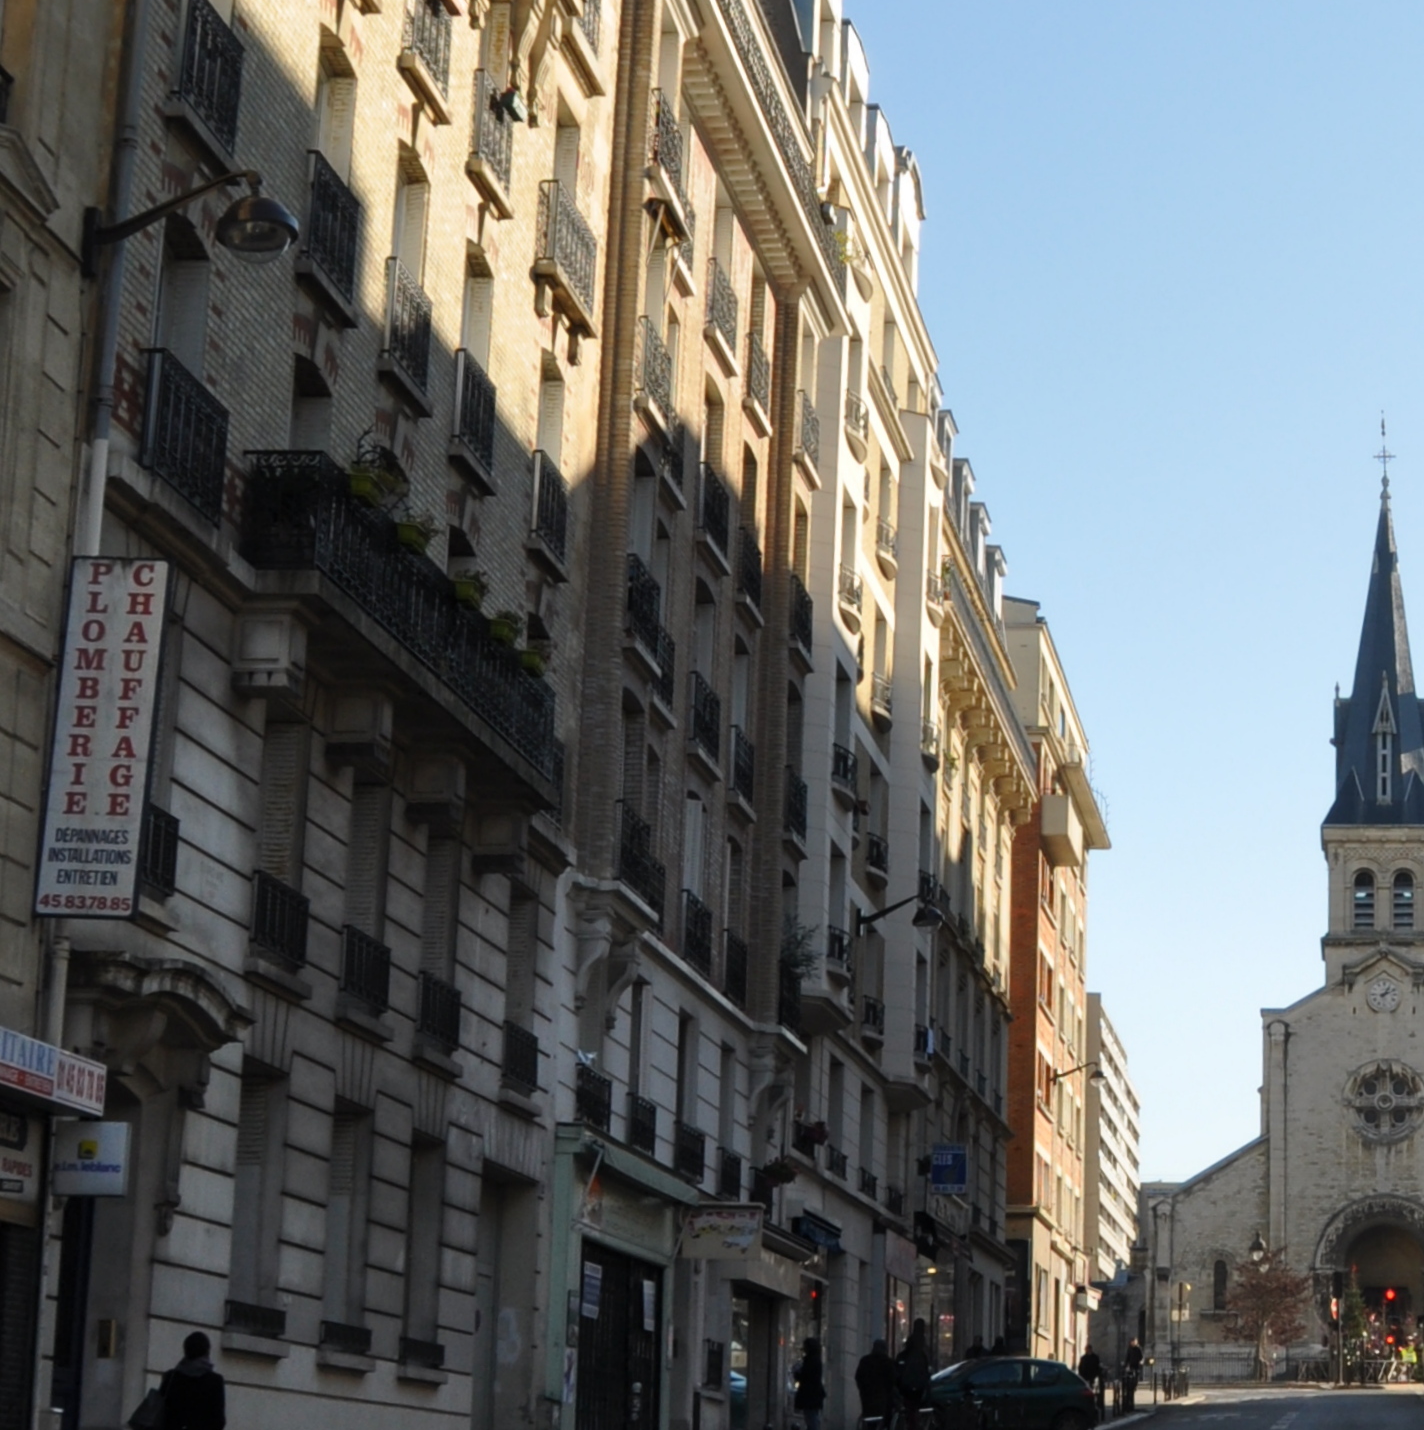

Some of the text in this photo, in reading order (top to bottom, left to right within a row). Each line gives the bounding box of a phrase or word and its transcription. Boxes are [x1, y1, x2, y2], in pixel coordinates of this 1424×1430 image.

[62, 562, 111, 816] PLOMBERIE
[105, 563, 156, 818] CHAUFFAGE
[54, 827, 130, 845] DÉPANNAGES
[47, 847, 133, 865] INSTALLATIONS
[55, 868, 118, 886] ENTRETIEN
[81, 1160, 121, 1173] leblanc
